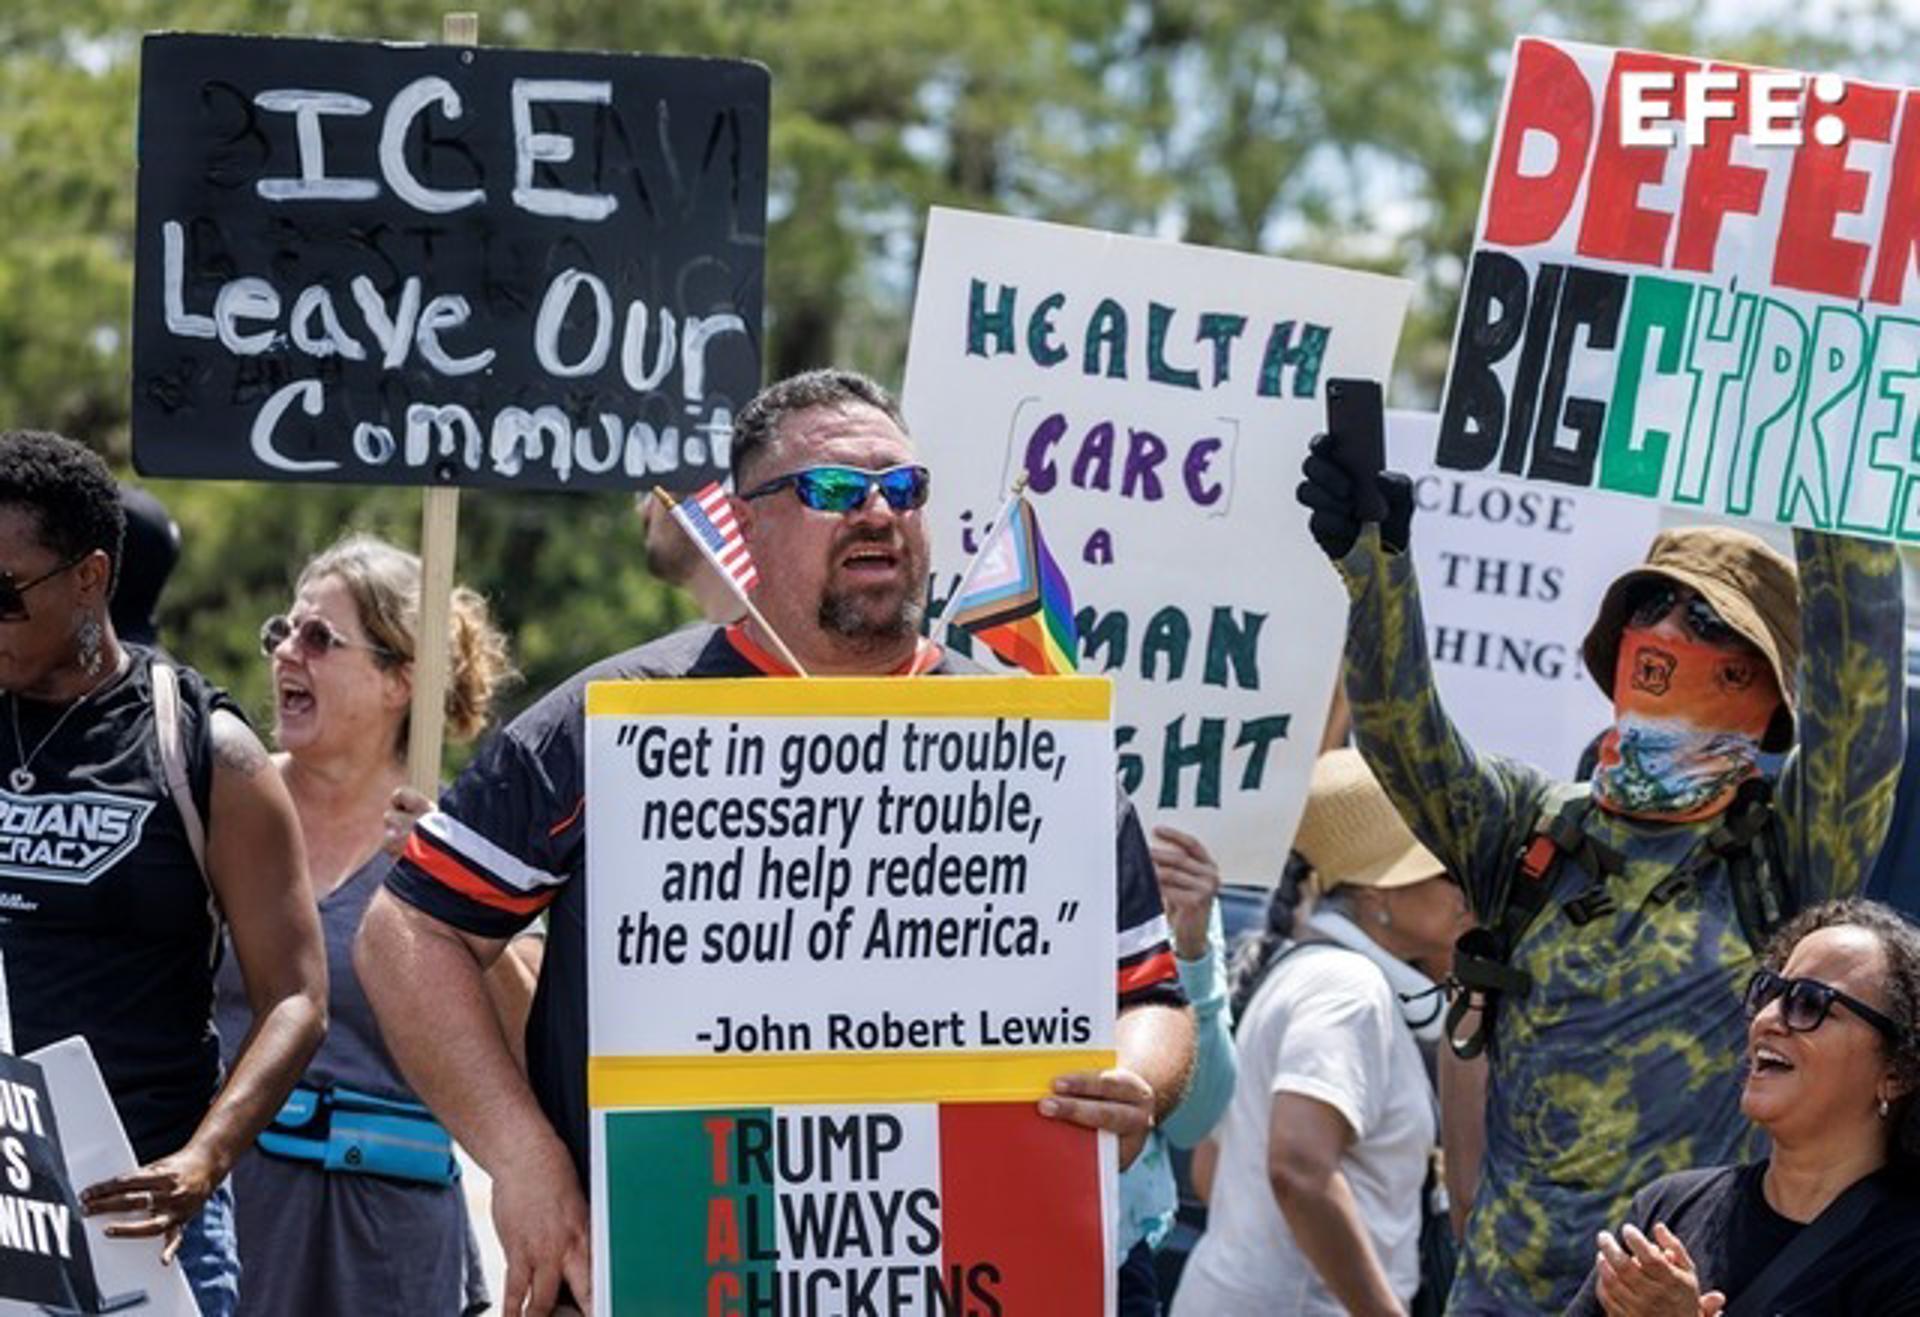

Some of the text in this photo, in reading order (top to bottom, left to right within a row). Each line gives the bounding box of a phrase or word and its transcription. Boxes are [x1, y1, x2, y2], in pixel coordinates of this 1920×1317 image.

[253, 76, 618, 221] ICE
[163, 220, 745, 400] Leave Our
[964, 278, 1332, 399] HEALTH
[1435, 249, 1920, 541] BIG CYPRE
[1023, 413, 1224, 507] CARE
[960, 509, 1115, 566] i A
[1414, 474, 1577, 534] CLOSE
[1439, 551, 1565, 603] THIS
[923, 572, 1269, 691] HMAN
[725, 722, 764, 776] in
[780, 719, 889, 789] good
[903, 717, 1066, 781] trouble,
[642, 779, 1042, 850] necessary trouble,
[662, 842, 1027, 912] and help redeem
[617, 911, 688, 966] the
[701, 907, 794, 964] soul
[808, 905, 855, 961] of
[696, 1006, 1092, 1054] -John Robert Lewis
[704, 1114, 903, 1187] TRUMP
[706, 1189, 942, 1266] ALWAYS
[706, 1262, 1004, 1317] CHICKENS
